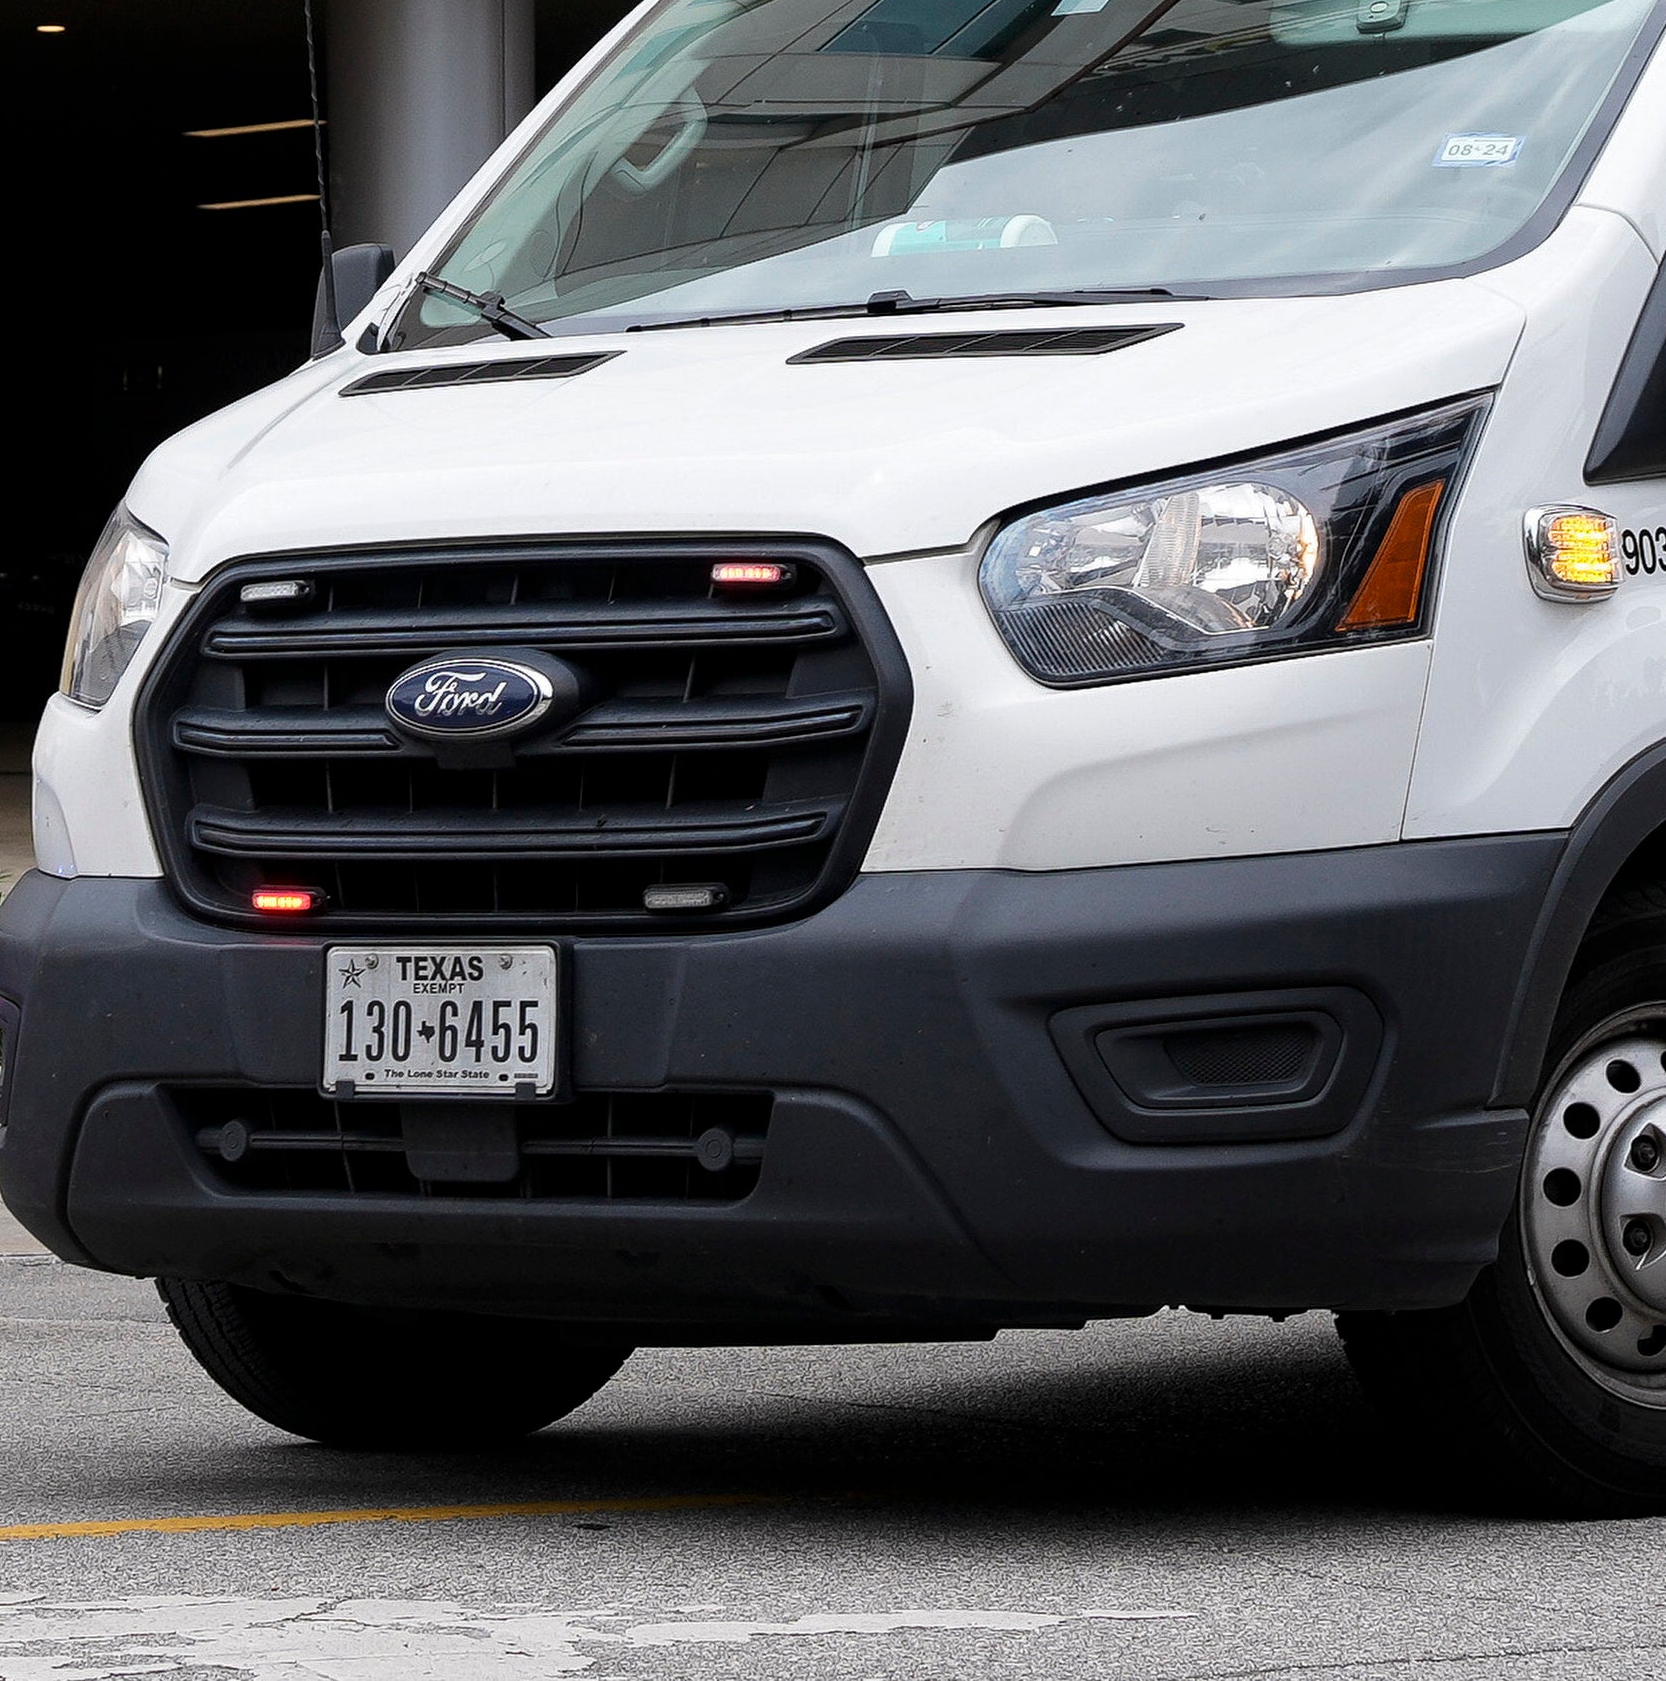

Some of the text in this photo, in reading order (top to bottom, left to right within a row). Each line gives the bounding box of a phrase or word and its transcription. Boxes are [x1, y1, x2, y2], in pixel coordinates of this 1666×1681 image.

[414, 671, 508, 716] Ford
[396, 955, 484, 982] TEXAS
[412, 982, 466, 995] EXEMPT
[384, 1068, 490, 1080] The Lone Star State
